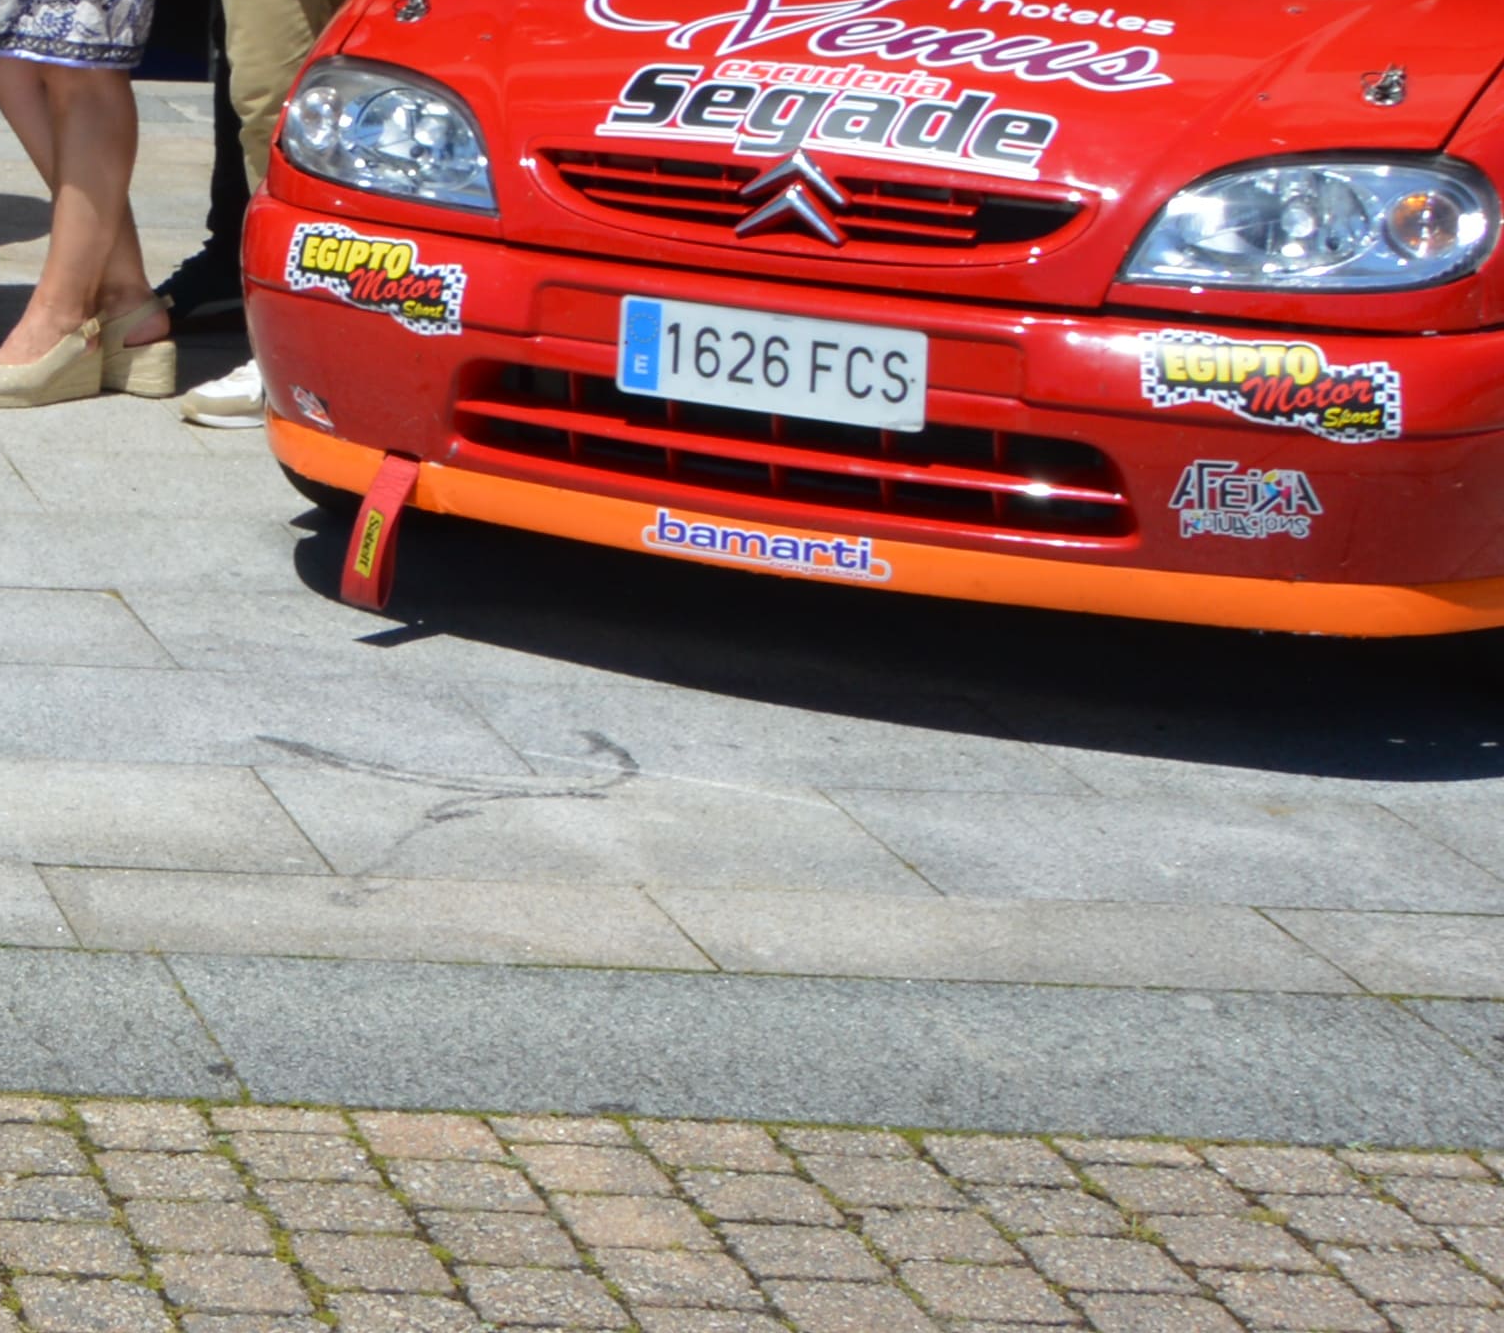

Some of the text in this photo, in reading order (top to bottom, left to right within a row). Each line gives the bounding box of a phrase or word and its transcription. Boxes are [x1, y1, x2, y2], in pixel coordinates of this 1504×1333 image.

[714, 60, 950, 99] escuderia
[300, 236, 412, 279] EGIPTO
[348, 268, 443, 301] Motor
[633, 323, 909, 404] E 1626 FCS
[1162, 344, 1321, 385] EGIPTO
[1241, 376, 1374, 412] Motor
[1322, 407, 1380, 429] Sport
[656, 511, 871, 571] bamarti
